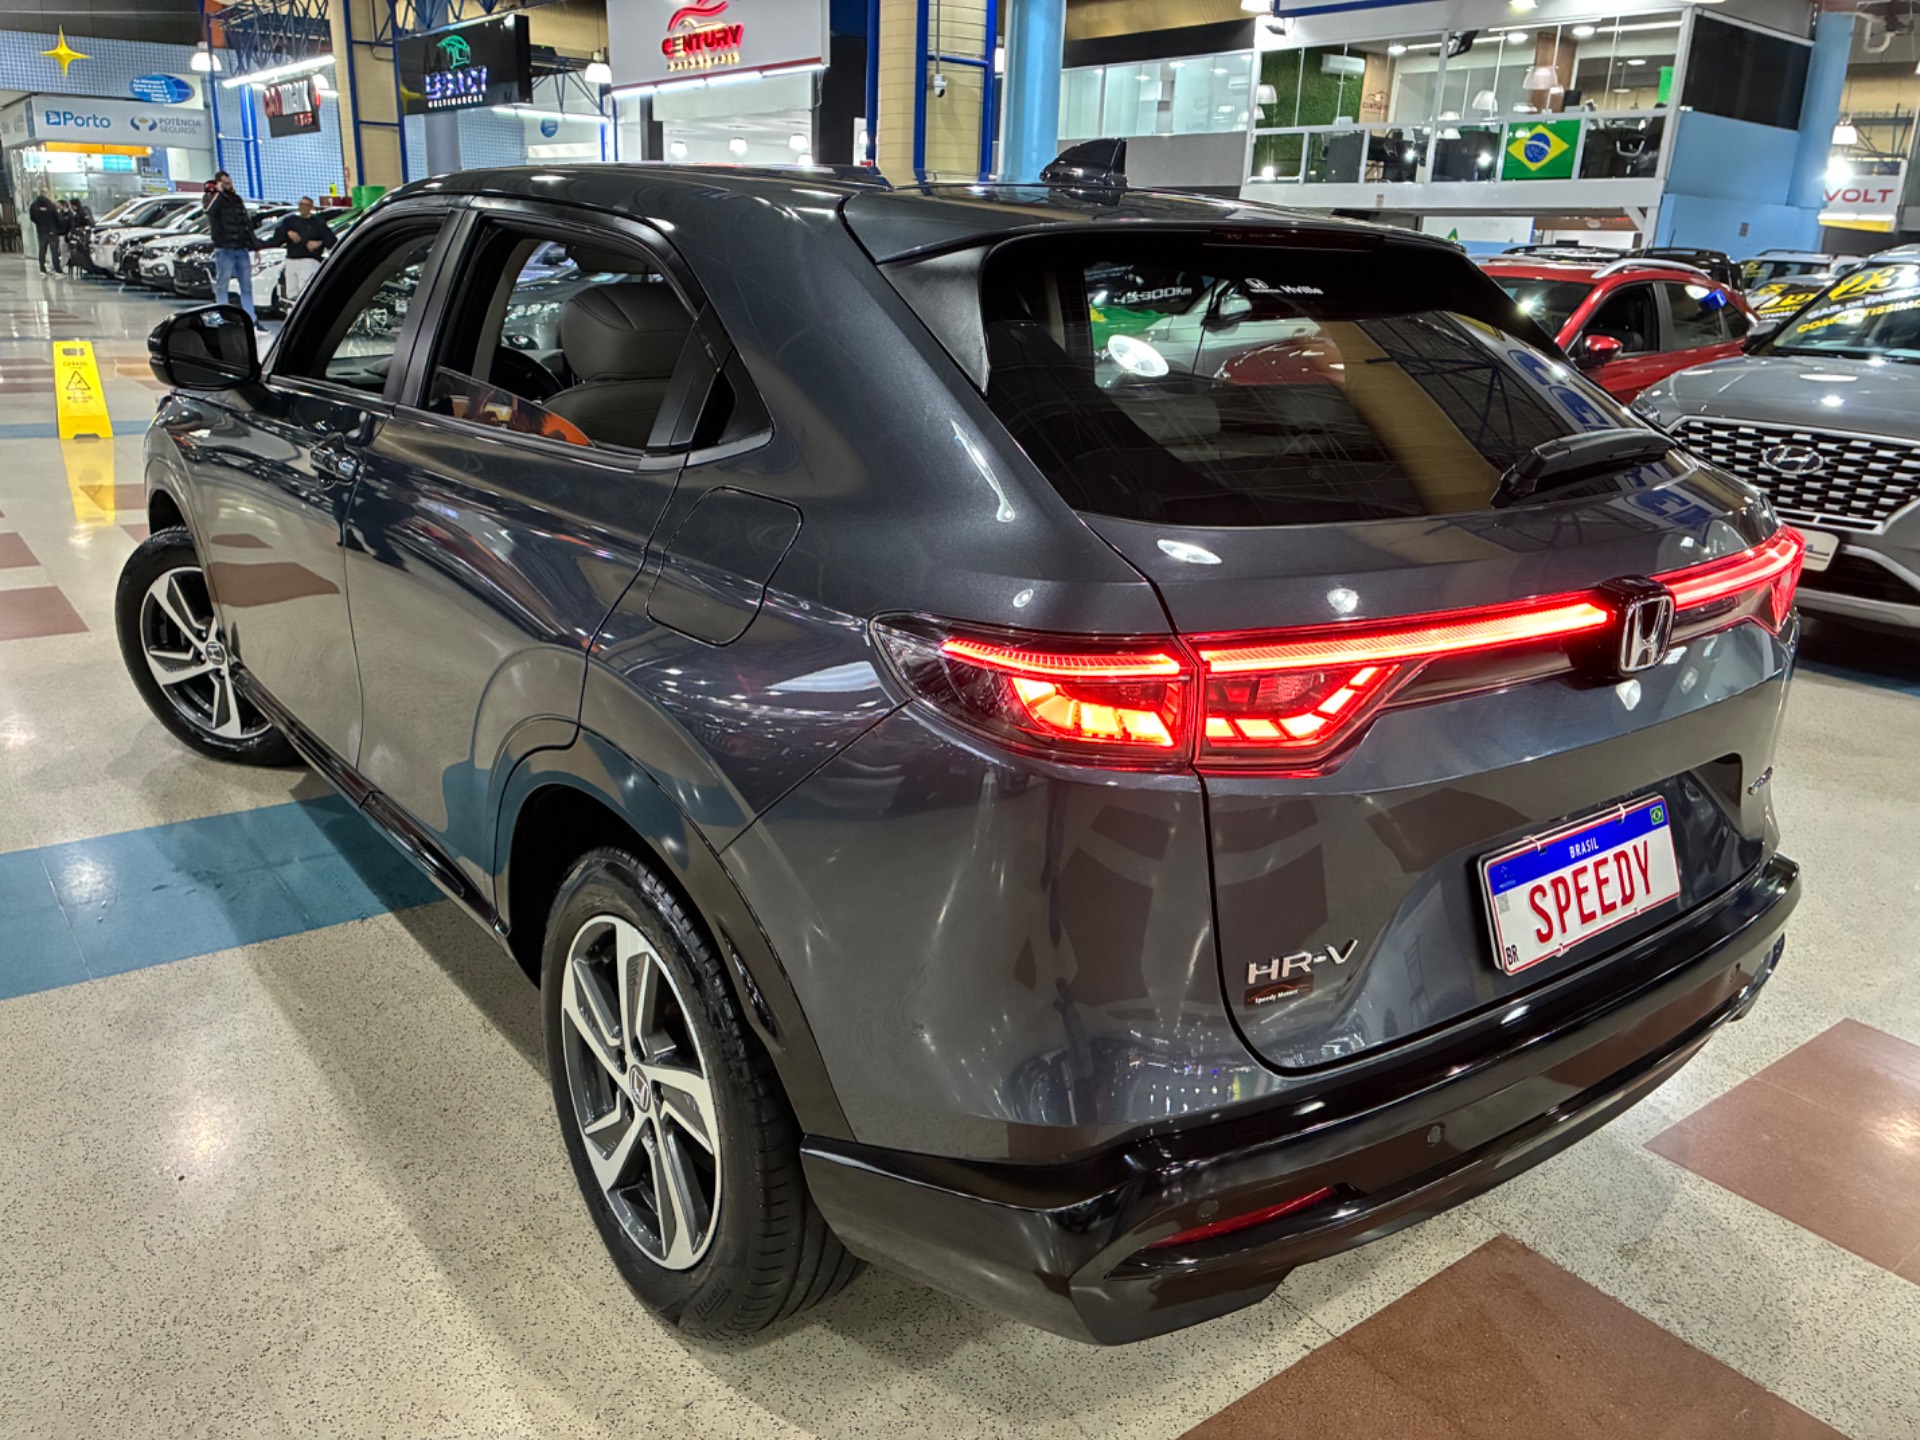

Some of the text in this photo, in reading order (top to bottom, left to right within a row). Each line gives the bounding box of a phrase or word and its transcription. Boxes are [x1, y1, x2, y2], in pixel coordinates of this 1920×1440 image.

[661, 23, 744, 58] CENTURY
[62, 111, 111, 128] Porto
[1824, 188, 1895, 204] VOLT
[1569, 836, 1599, 859] BRASIL
[1528, 840, 1651, 944] SPEEDY
[1247, 939, 1359, 985] HR-V
[1505, 944, 1520, 966] BR
